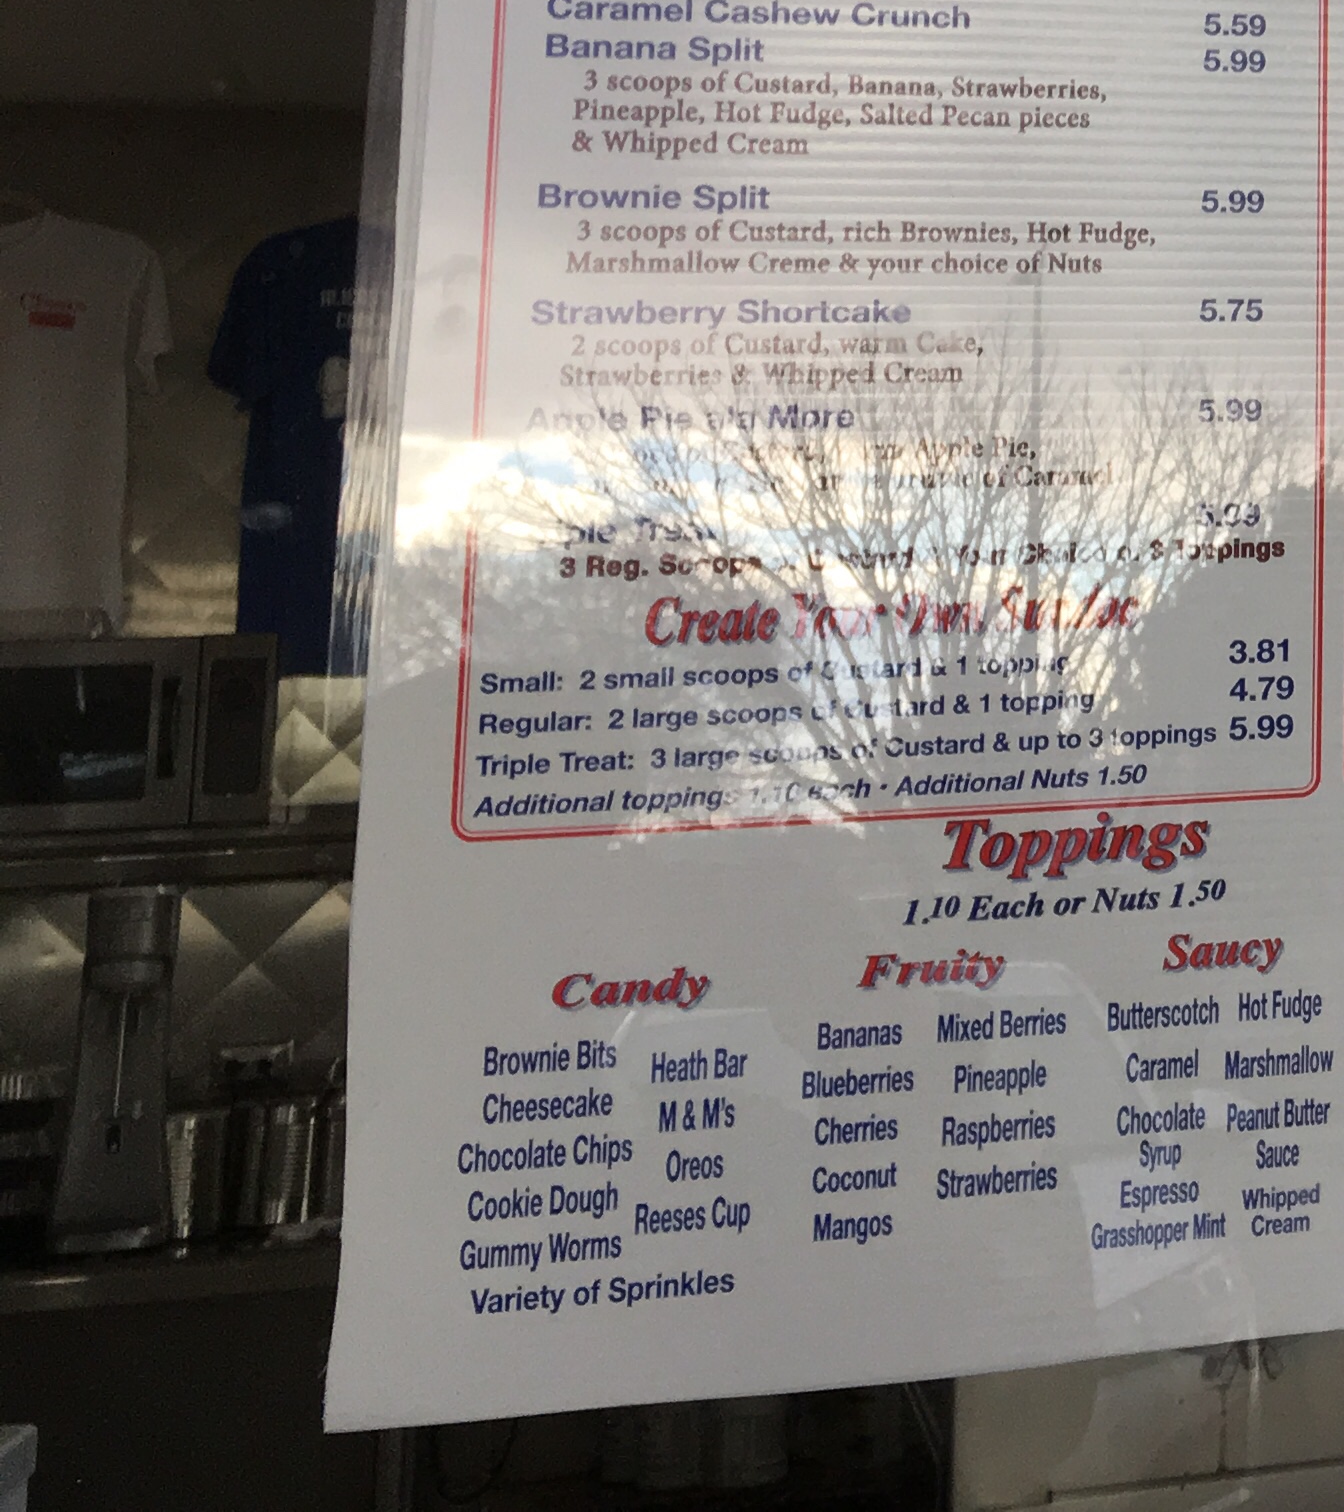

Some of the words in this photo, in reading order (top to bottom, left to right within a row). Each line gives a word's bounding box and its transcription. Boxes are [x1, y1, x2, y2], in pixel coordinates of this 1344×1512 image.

[851, 2, 970, 29] Crunch
[1204, 13, 1266, 37] 5.59
[538, 184, 681, 209] Brownie
[693, 184, 770, 215] Split
[1202, 190, 1264, 213] 5.99
[942, 812, 1211, 882] Toppings
[856, 949, 1006, 990] Fruity
[1163, 934, 1284, 974] Saucy
[552, 967, 711, 1011] Candy
[938, 1011, 994, 1043] Mixed
[1000, 1007, 1066, 1038] Berries
[954, 1059, 1047, 1096] Pineapple
[483, 1088, 613, 1124] Cheesecake
[1121, 1180, 1199, 1212] Espresso
[471, 1285, 565, 1314] Variety
[574, 1279, 601, 1305] of
[608, 1270, 734, 1306] Sprinkles
